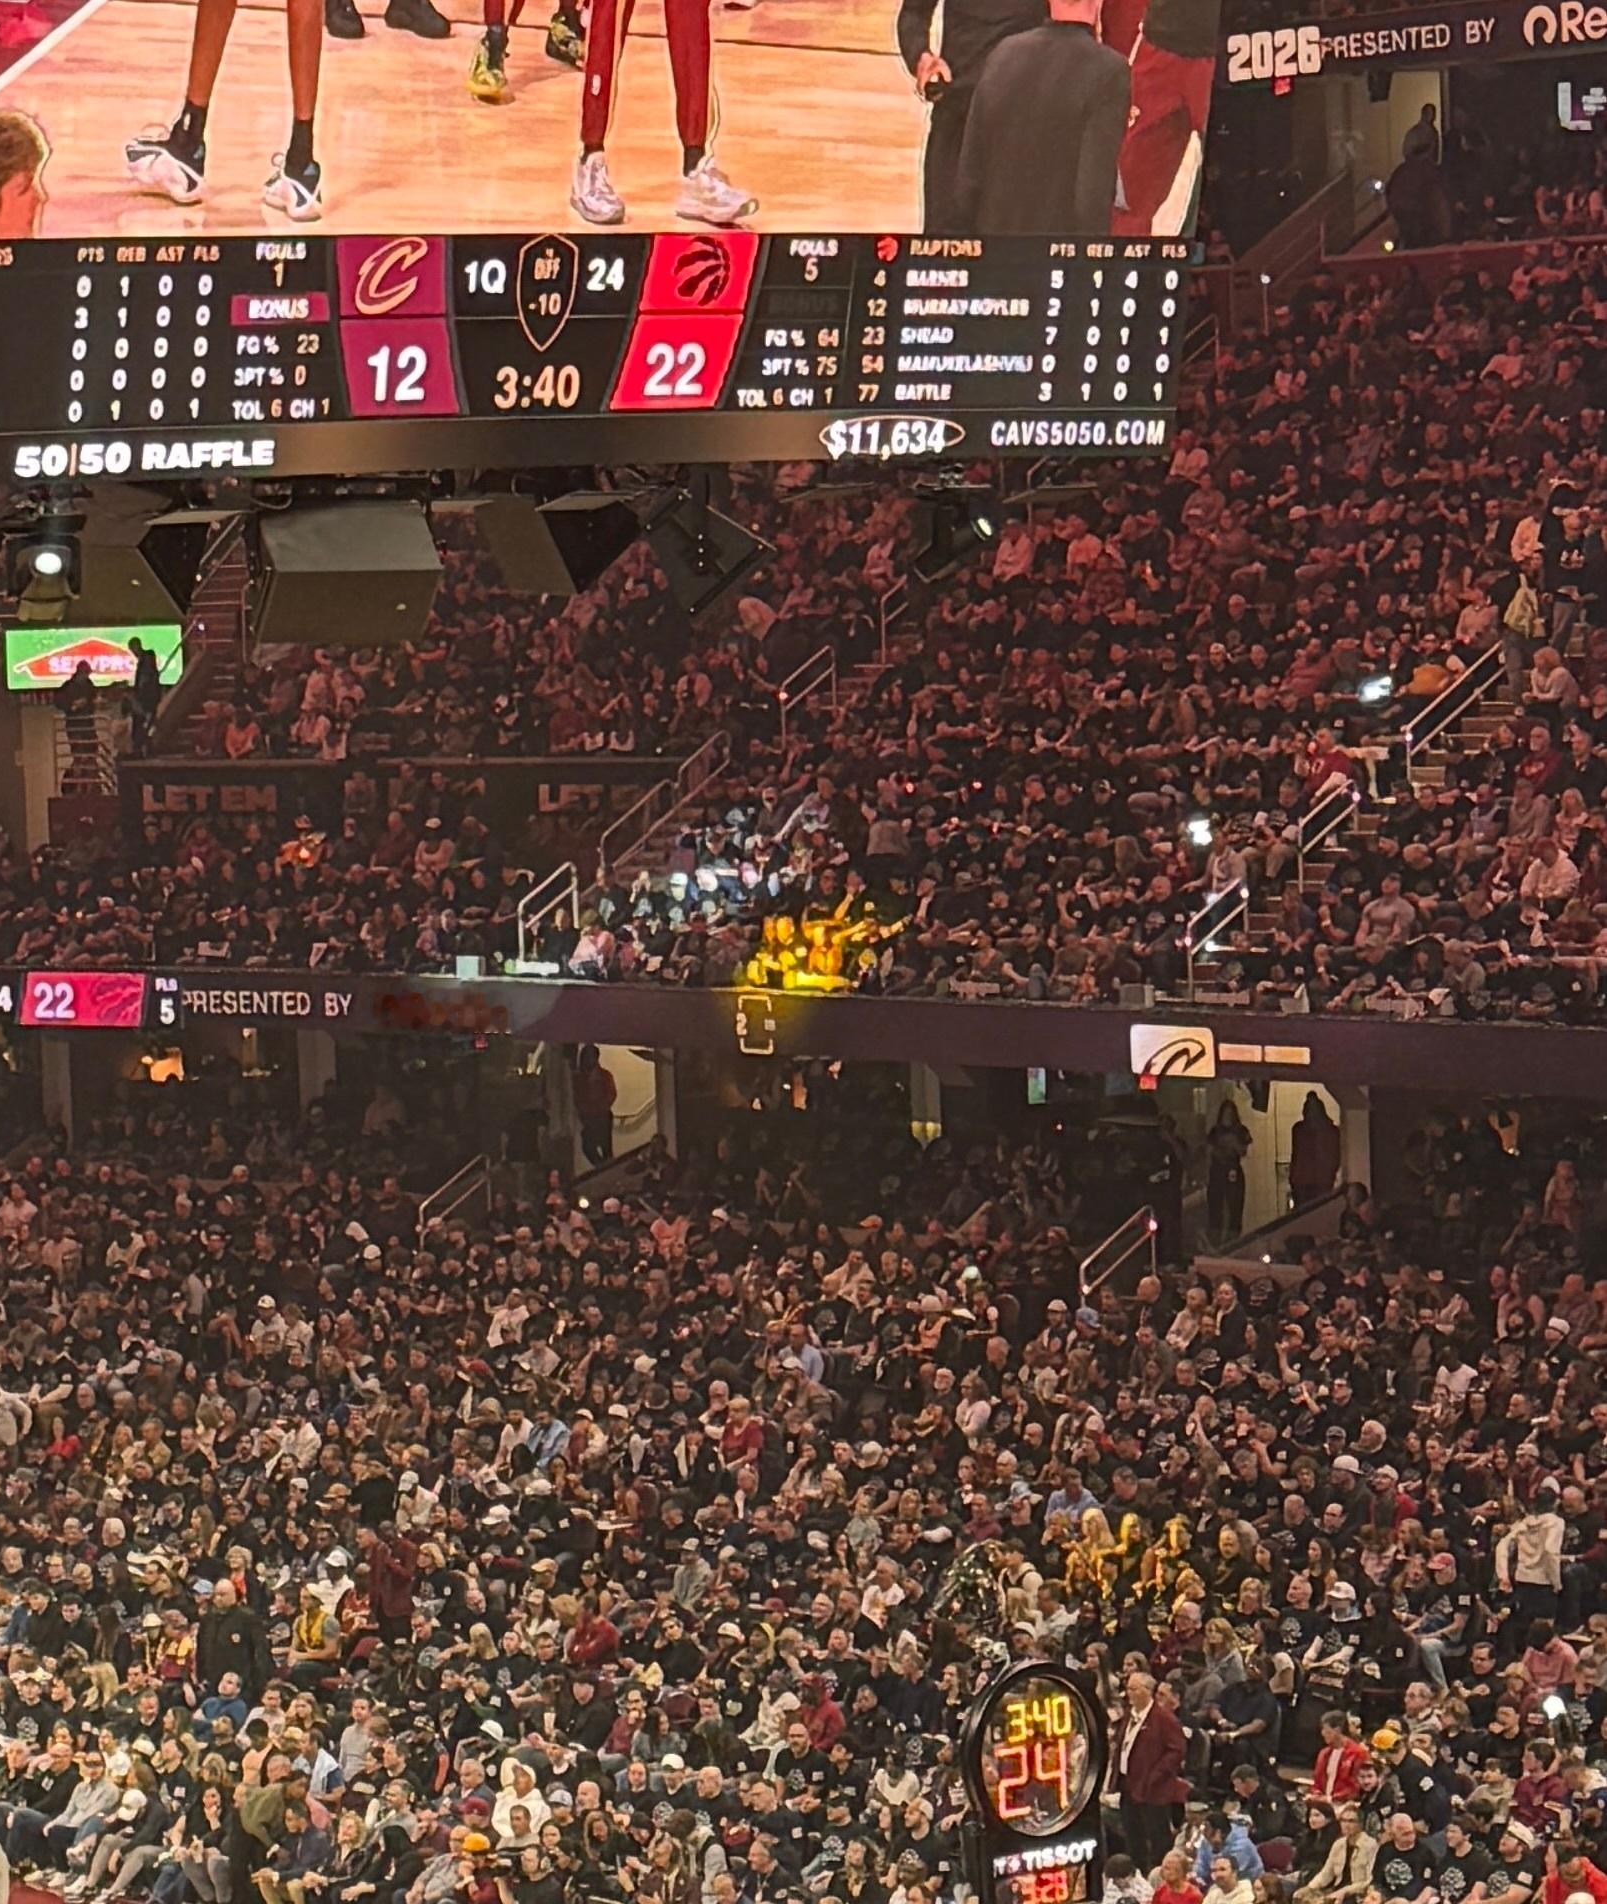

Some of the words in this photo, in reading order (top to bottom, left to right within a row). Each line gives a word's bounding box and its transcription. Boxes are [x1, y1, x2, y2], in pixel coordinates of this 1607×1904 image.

[1227, 26, 1322, 83] 2026
[1319, 23, 1451, 61] PRESENTED
[1465, 17, 1495, 45] BY
[156, 245, 185, 262] AST
[464, 259, 506, 295] 1Q
[586, 257, 625, 293] 24
[804, 258, 819, 283] 5
[77, 274, 93, 299] 0
[158, 274, 174, 297] 0
[198, 273, 214, 297] 0
[156, 305, 172, 329] 0
[195, 304, 211, 328] 0
[867, 298, 887, 318] 12
[72, 338, 87, 362] 0
[114, 337, 129, 360] 0
[153, 336, 169, 359] 0
[296, 333, 320, 355] 23
[862, 326, 886, 346] 23
[367, 344, 428, 403] 12
[642, 342, 706, 397] 22
[816, 356, 838, 376] 75
[494, 364, 581, 409] 3:40
[736, 389, 767, 408] TOL
[858, 383, 880, 402] 77
[232, 399, 266, 421] TOL
[290, 398, 315, 419] CH
[826, 419, 946, 461] $11,634
[990, 419, 1167, 448] CAVS5050.COM
[141, 439, 276, 472] RAFFLE
[142, 784, 217, 812] LET
[220, 784, 278, 812] EM
[155, 976, 178, 993] FLS
[33, 982, 77, 1020] 22
[159, 997, 175, 1026] 5
[180, 987, 312, 1017] PRESENTED
[324, 991, 354, 1017] BY
[1006, 1696, 1071, 1743] 3:40
[995, 1741, 1069, 1820] 24
[1022, 1838, 1097, 1869] TISSOT
